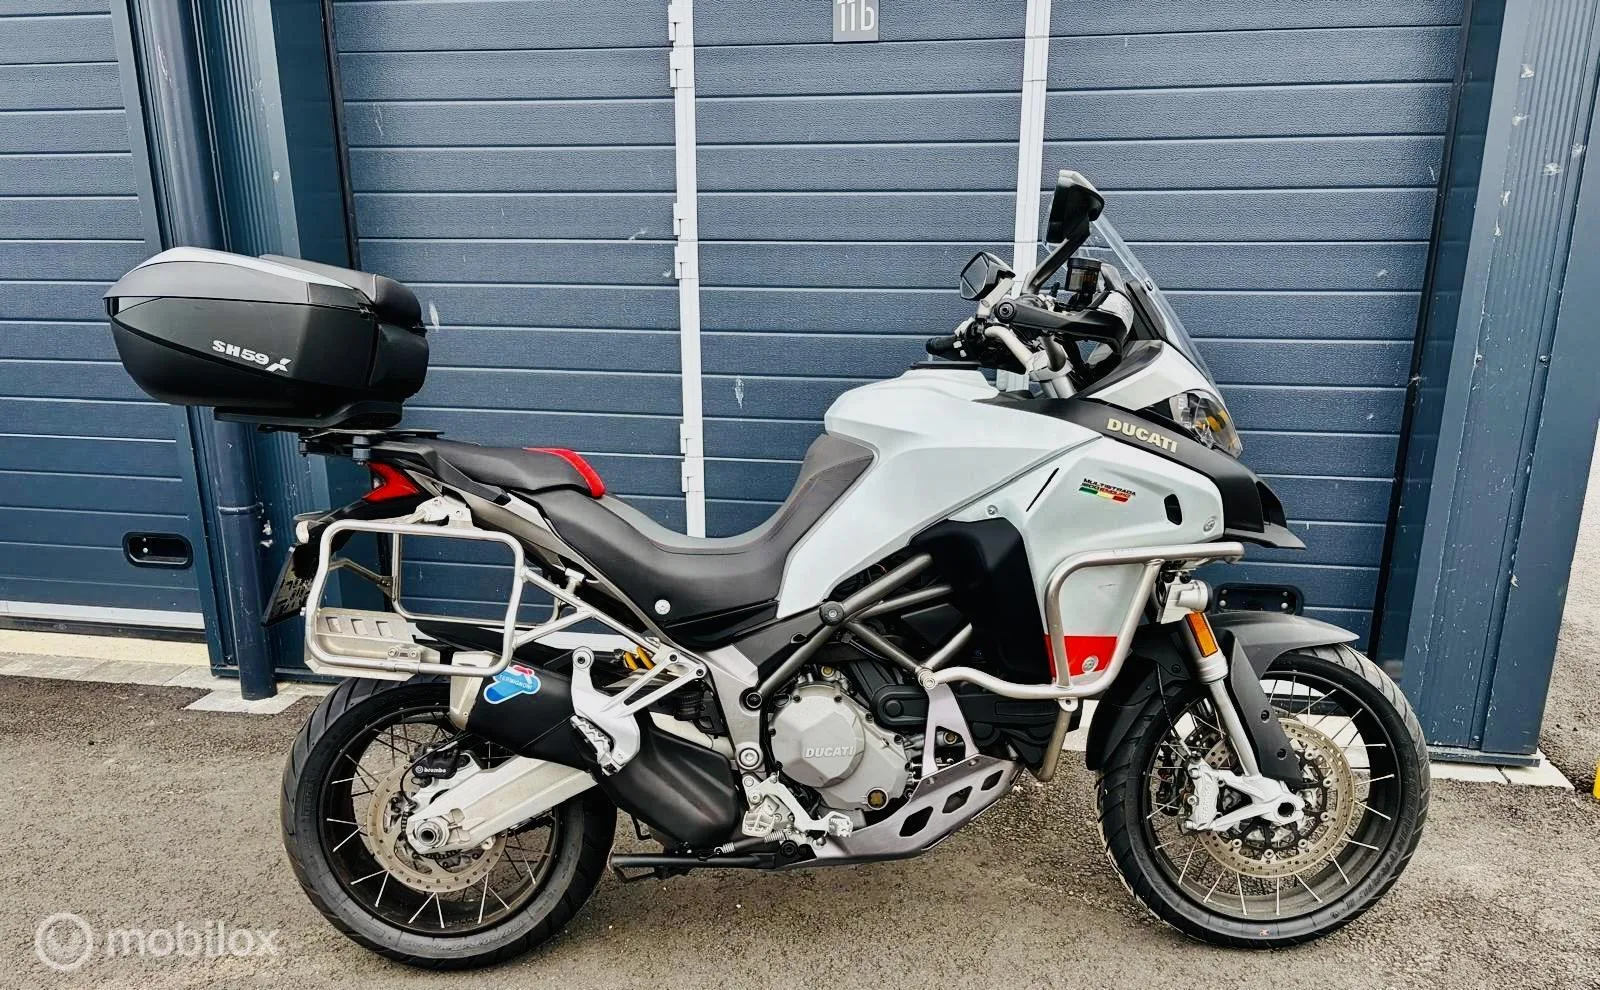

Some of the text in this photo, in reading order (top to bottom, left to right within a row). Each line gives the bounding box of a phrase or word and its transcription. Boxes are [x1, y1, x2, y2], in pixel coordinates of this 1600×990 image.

[836, 0, 875, 31] 11b
[1106, 417, 1178, 453] DUCATI
[1083, 477, 1136, 496] MULTISTRADA
[805, 745, 854, 758] DUCATI
